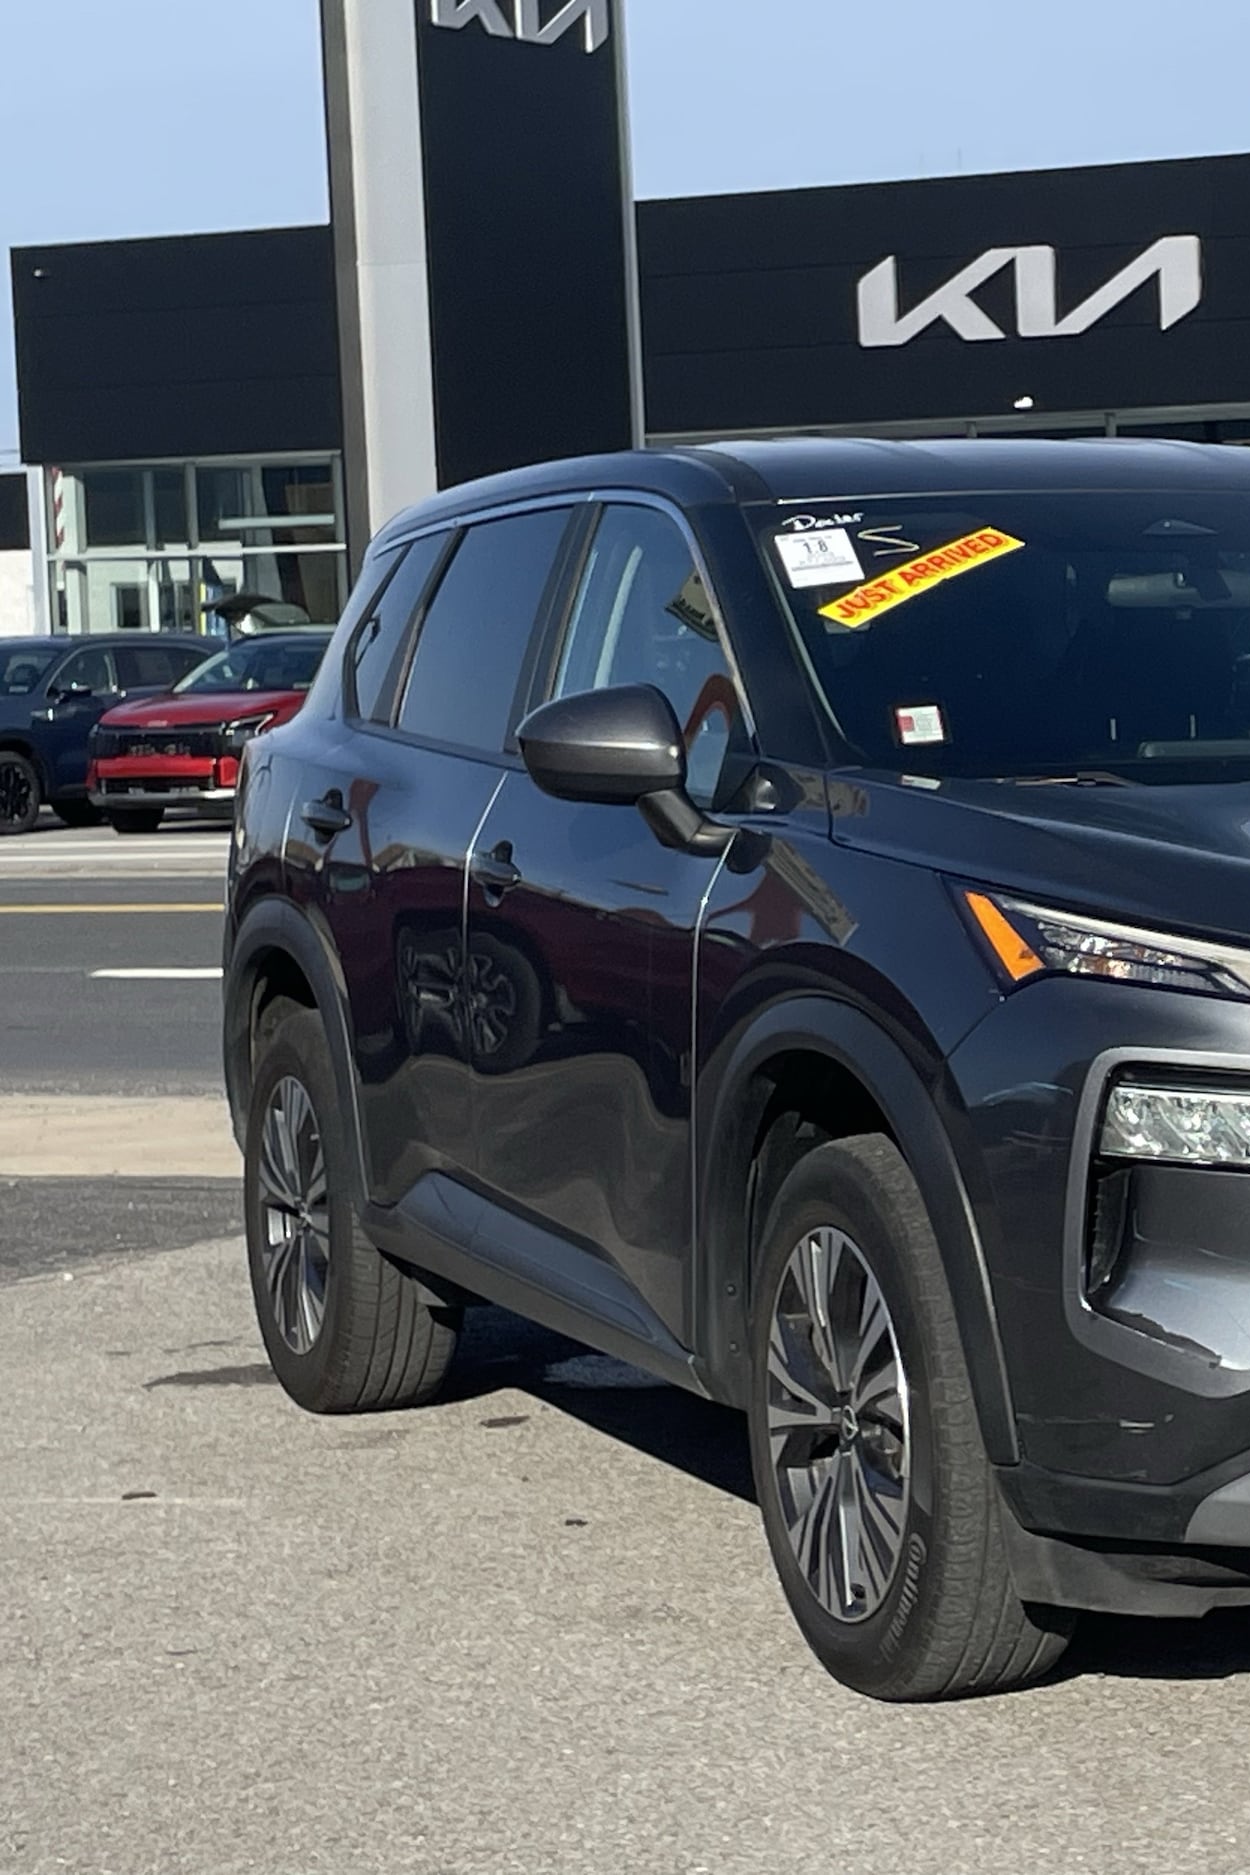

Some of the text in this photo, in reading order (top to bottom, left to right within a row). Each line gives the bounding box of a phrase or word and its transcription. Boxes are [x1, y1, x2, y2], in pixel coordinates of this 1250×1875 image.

[857, 234, 1201, 348] KIA
[836, 579, 899, 619] JUST
[897, 532, 1004, 587] ARRIVED
